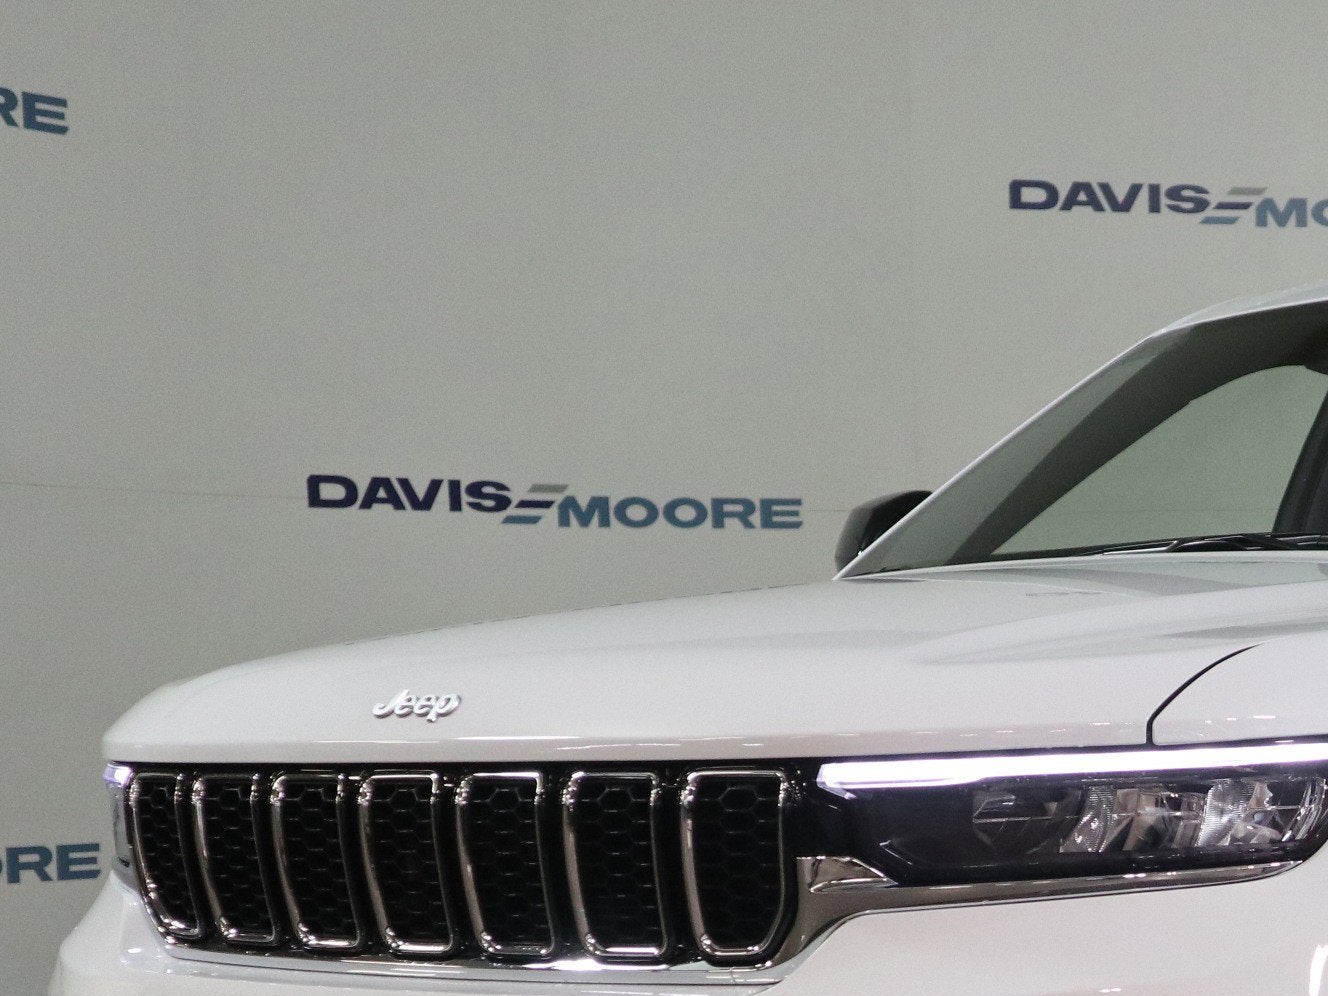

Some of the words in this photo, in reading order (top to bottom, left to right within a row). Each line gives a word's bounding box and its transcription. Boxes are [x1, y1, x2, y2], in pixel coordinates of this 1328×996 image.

[1008, 179, 1211, 214] DAVIS
[306, 474, 513, 513] DAVIS
[557, 495, 803, 530] MOORE
[372, 689, 461, 723] Jeep
